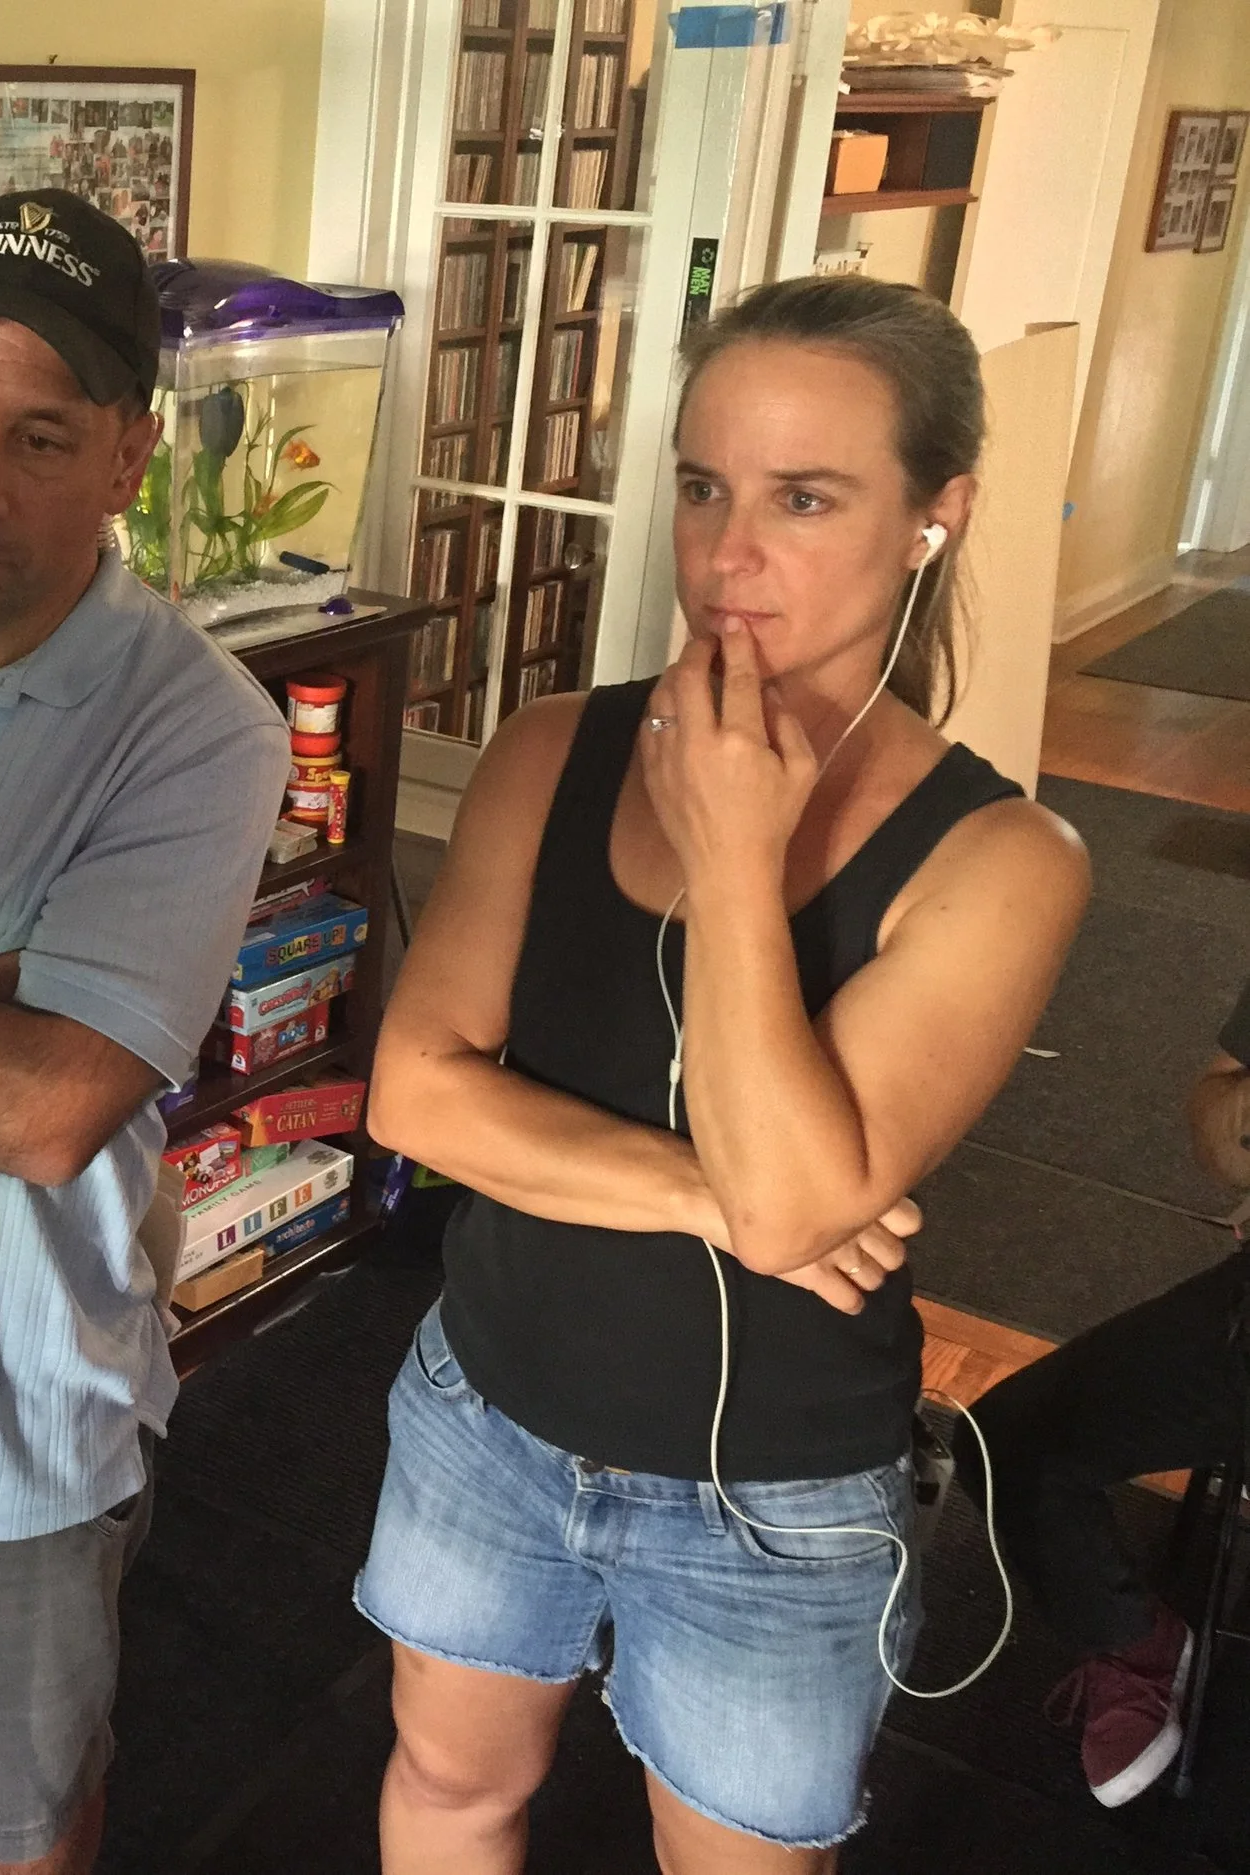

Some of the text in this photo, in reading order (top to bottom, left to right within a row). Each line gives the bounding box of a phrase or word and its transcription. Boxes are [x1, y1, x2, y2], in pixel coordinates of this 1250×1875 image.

[690, 267, 700, 295] MEN
[699, 267, 711, 296] MAT
[267, 935, 320, 962] SQUARE
[277, 1112, 317, 1131] CATAN
